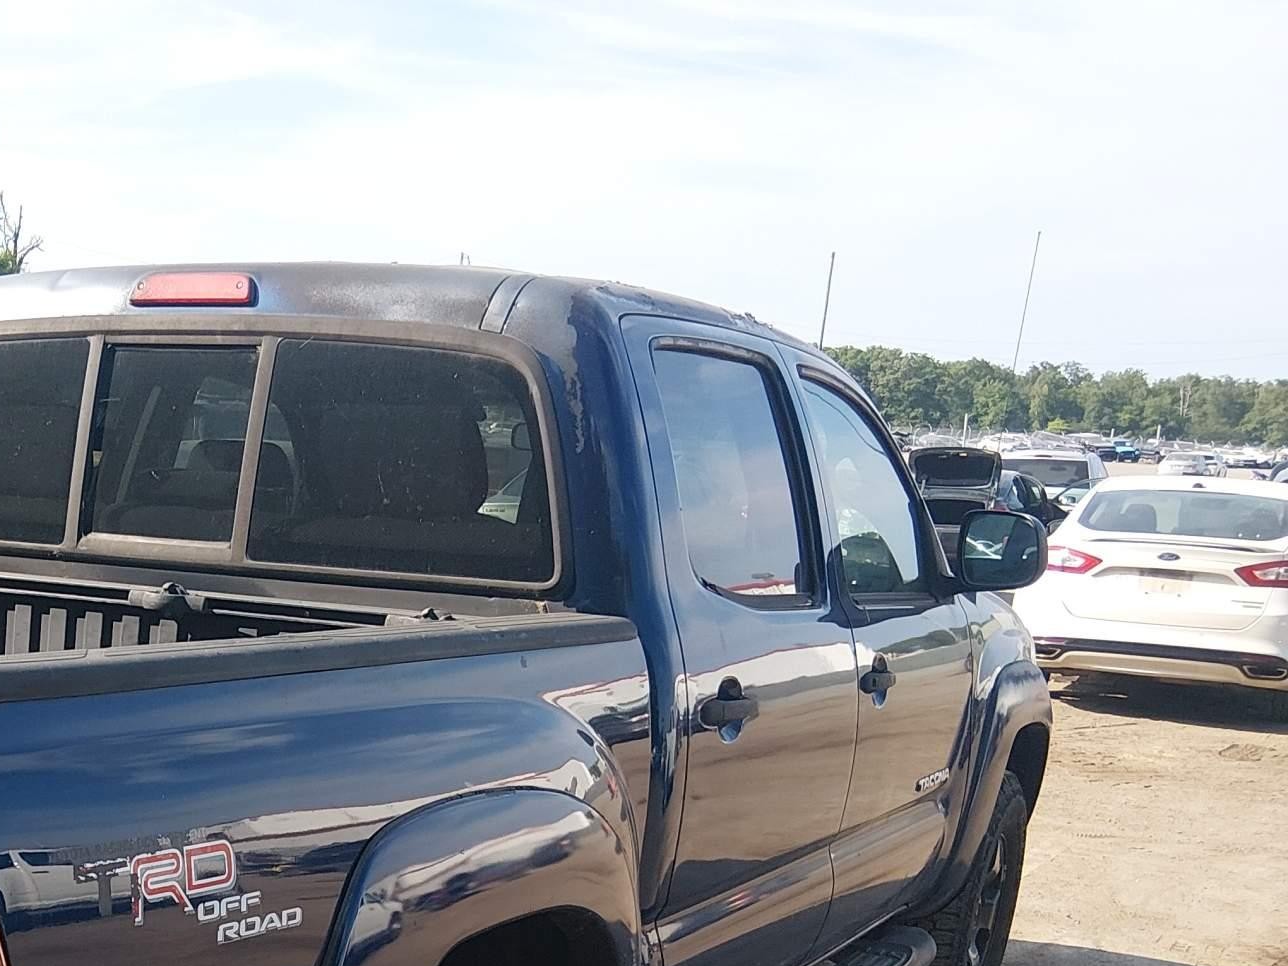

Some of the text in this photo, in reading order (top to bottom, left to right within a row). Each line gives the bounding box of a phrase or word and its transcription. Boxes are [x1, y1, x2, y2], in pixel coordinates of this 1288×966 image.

[74, 839, 236, 926] TRD
[197, 891, 261, 923] OFF
[217, 907, 303, 944] ROAD
